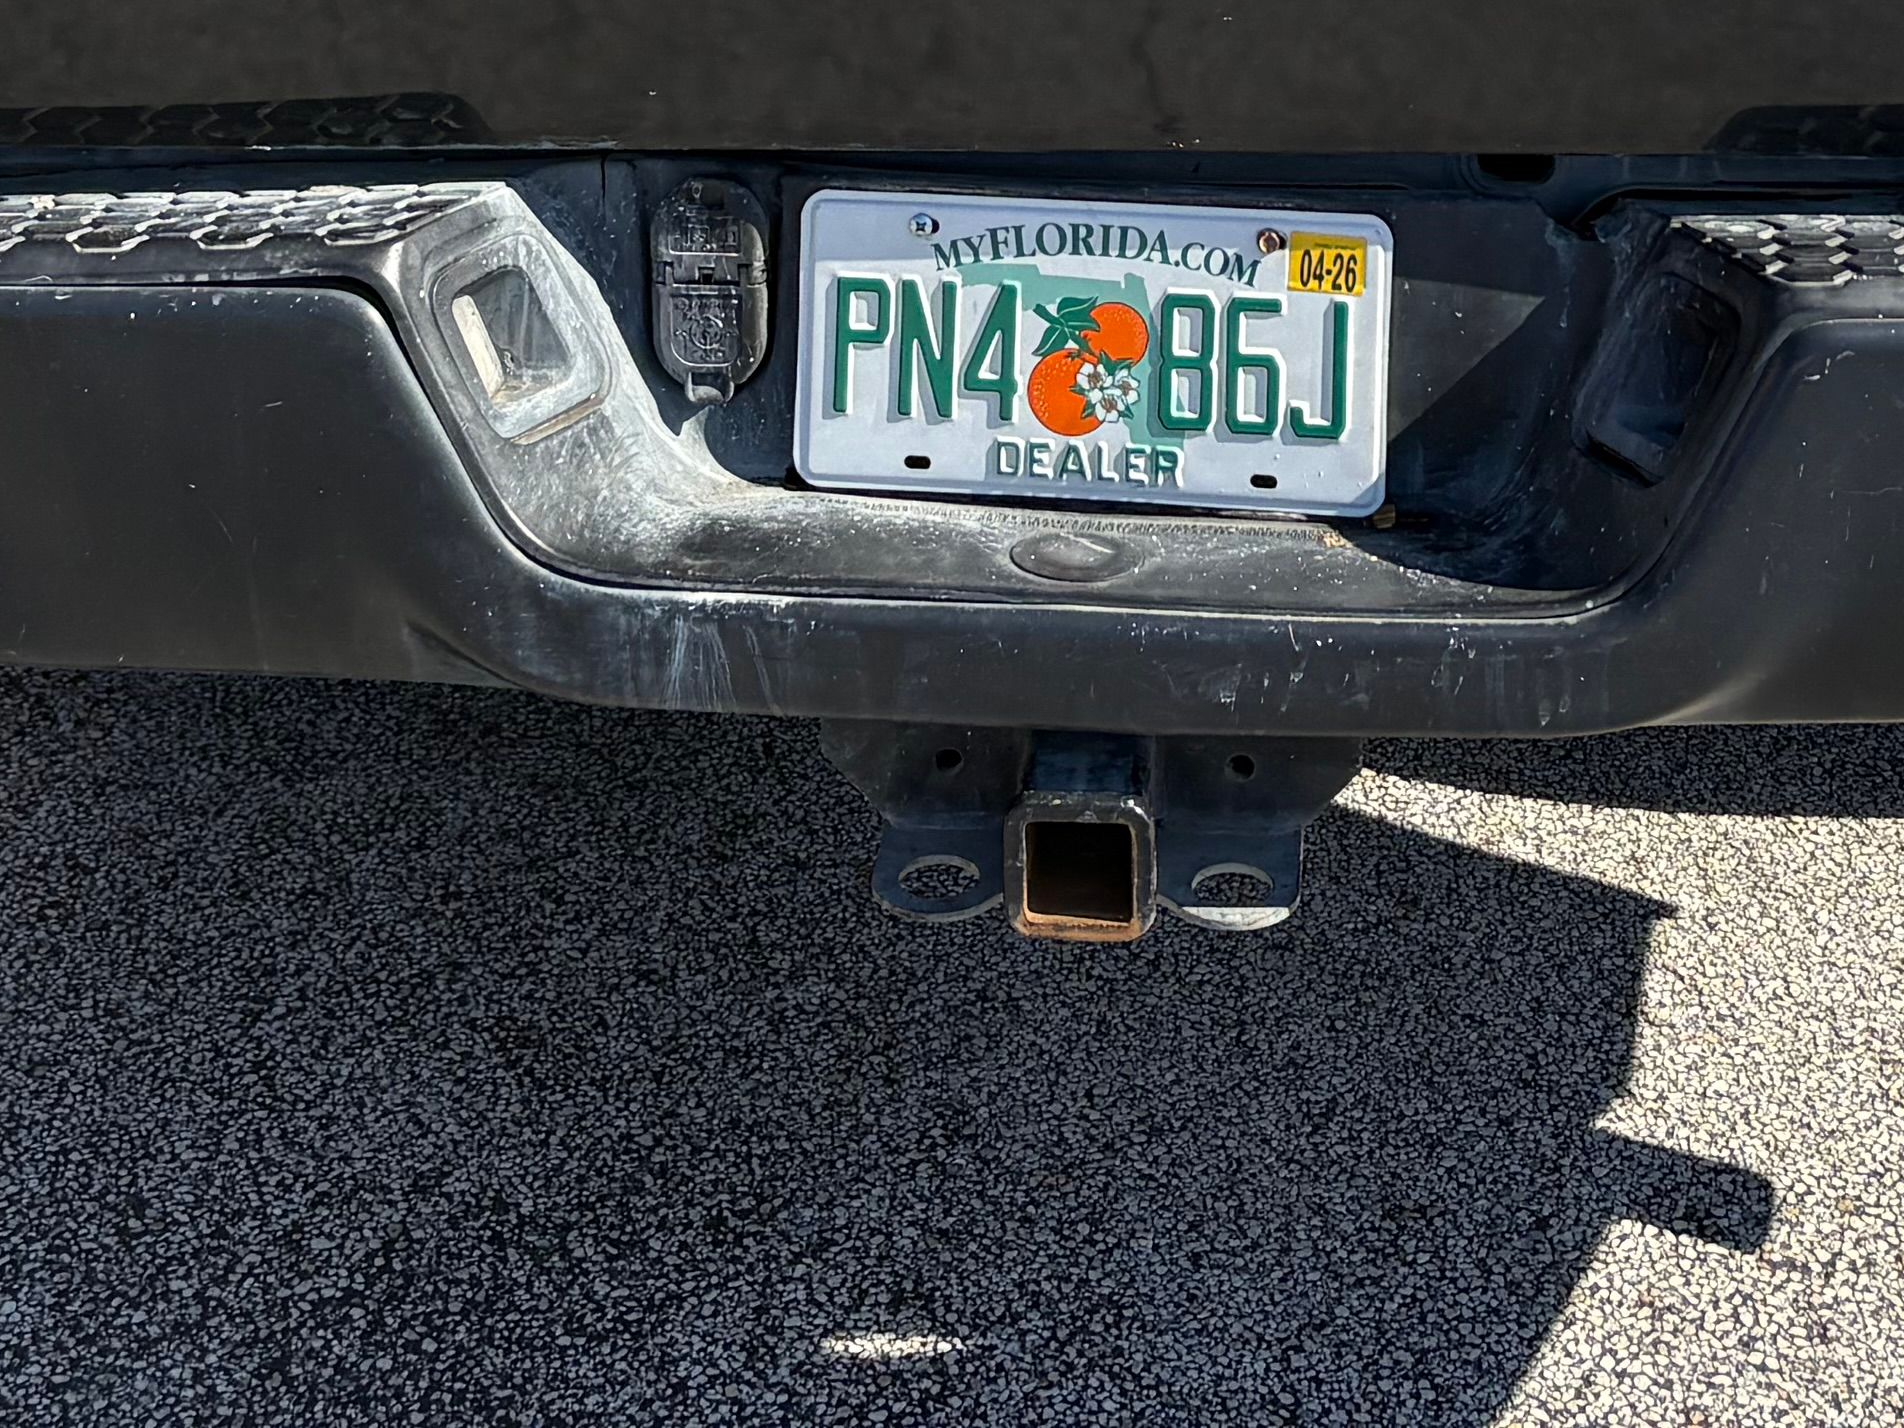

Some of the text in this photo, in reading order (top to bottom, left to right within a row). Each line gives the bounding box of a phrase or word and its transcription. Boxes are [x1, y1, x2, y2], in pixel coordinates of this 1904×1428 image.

[931, 222, 1261, 288] MYFLORIDA.COM
[1300, 249, 1358, 293] 04-26
[832, 276, 1022, 422] PN4
[1157, 289, 1349, 441] 86J
[996, 435, 1185, 489] DEALER
